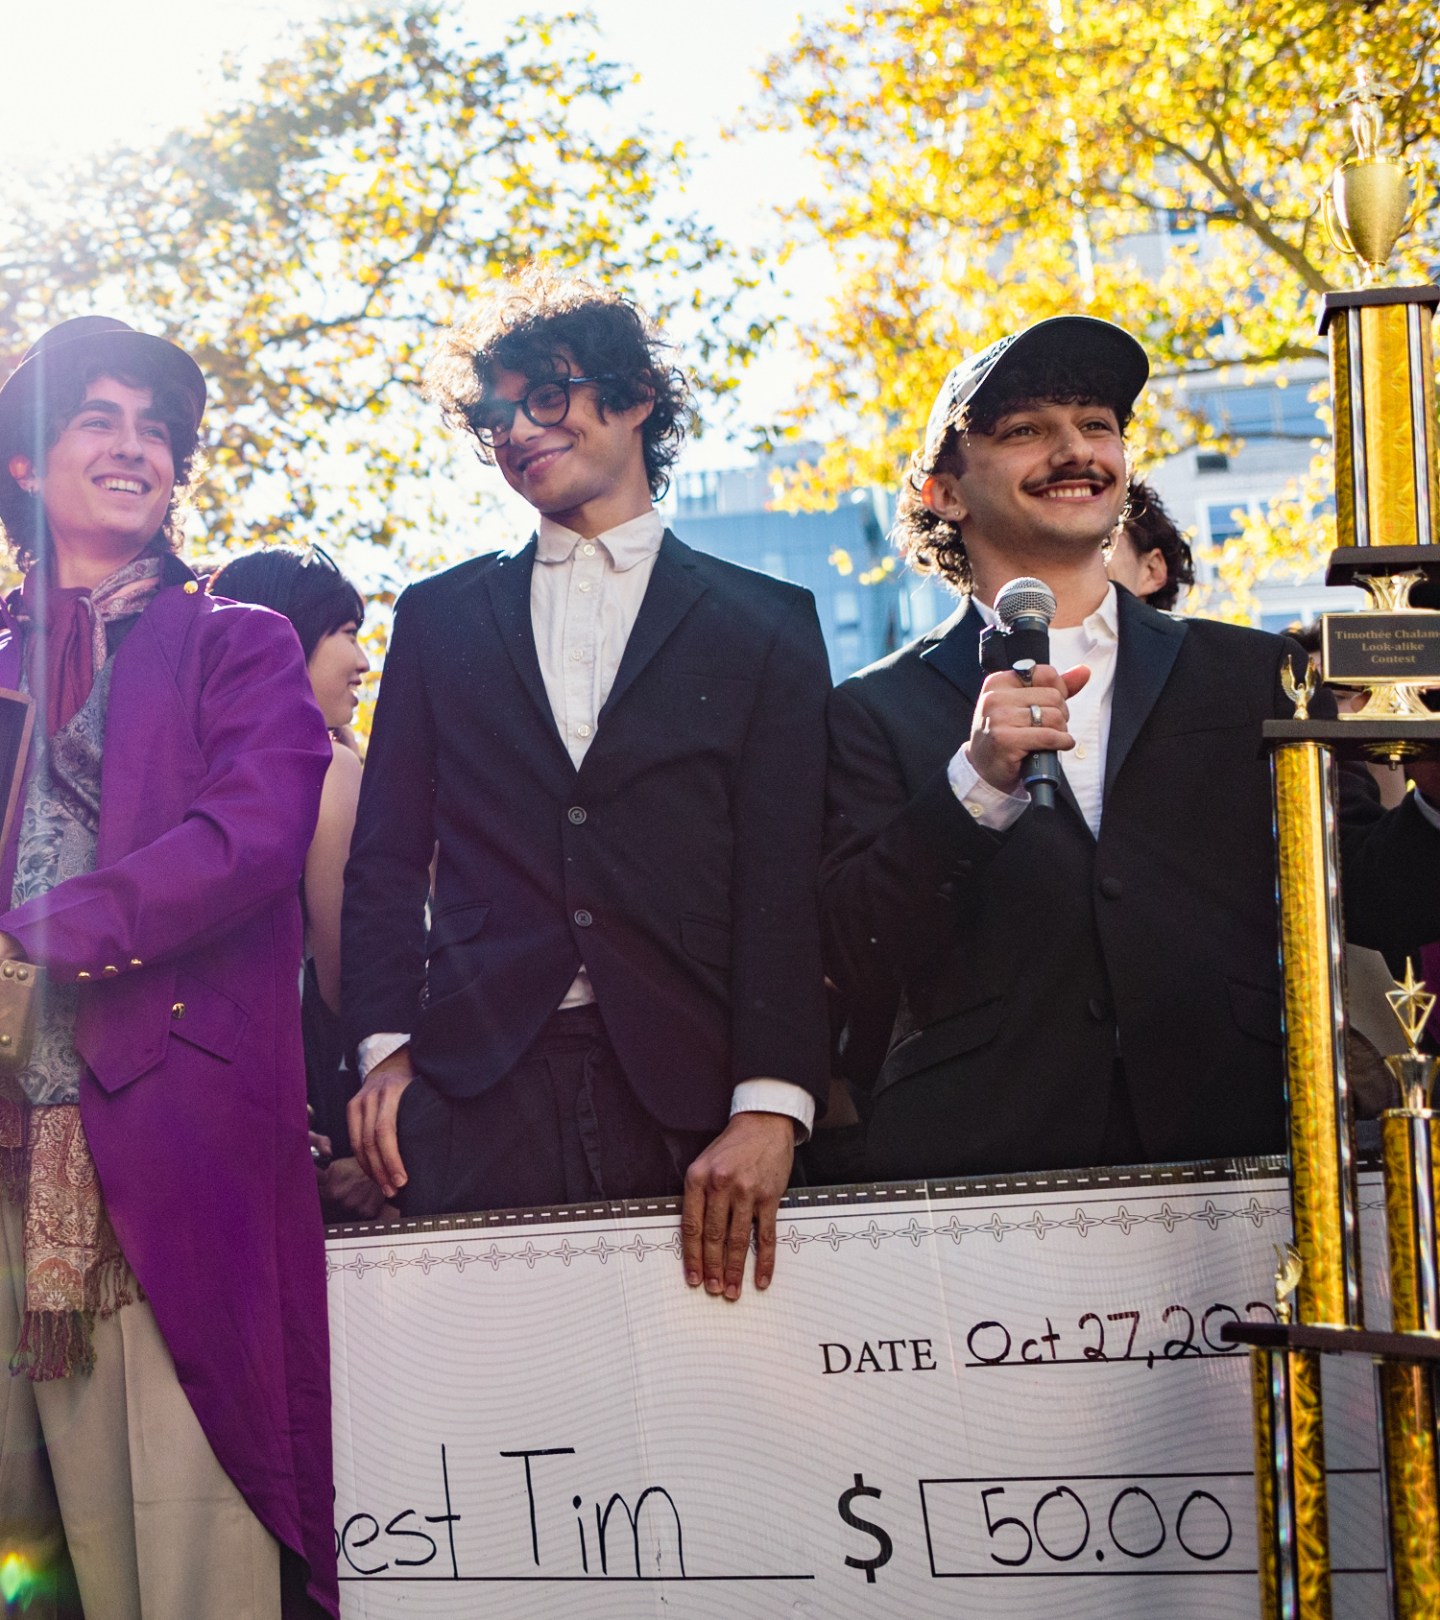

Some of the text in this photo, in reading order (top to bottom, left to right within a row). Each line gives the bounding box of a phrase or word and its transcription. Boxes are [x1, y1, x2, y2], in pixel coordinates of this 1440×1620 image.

[1334, 629, 1440, 640] Timothée Chalam
[1361, 642, 1425, 652] Look-alike
[1371, 654, 1416, 664] Contest
[819, 1339, 938, 1375] DATE
[966, 1316, 1060, 1364] Oct
[333, 1443, 686, 1581] est Tim
[837, 1473, 894, 1583] $
[980, 1485, 1233, 1567] 50.00
